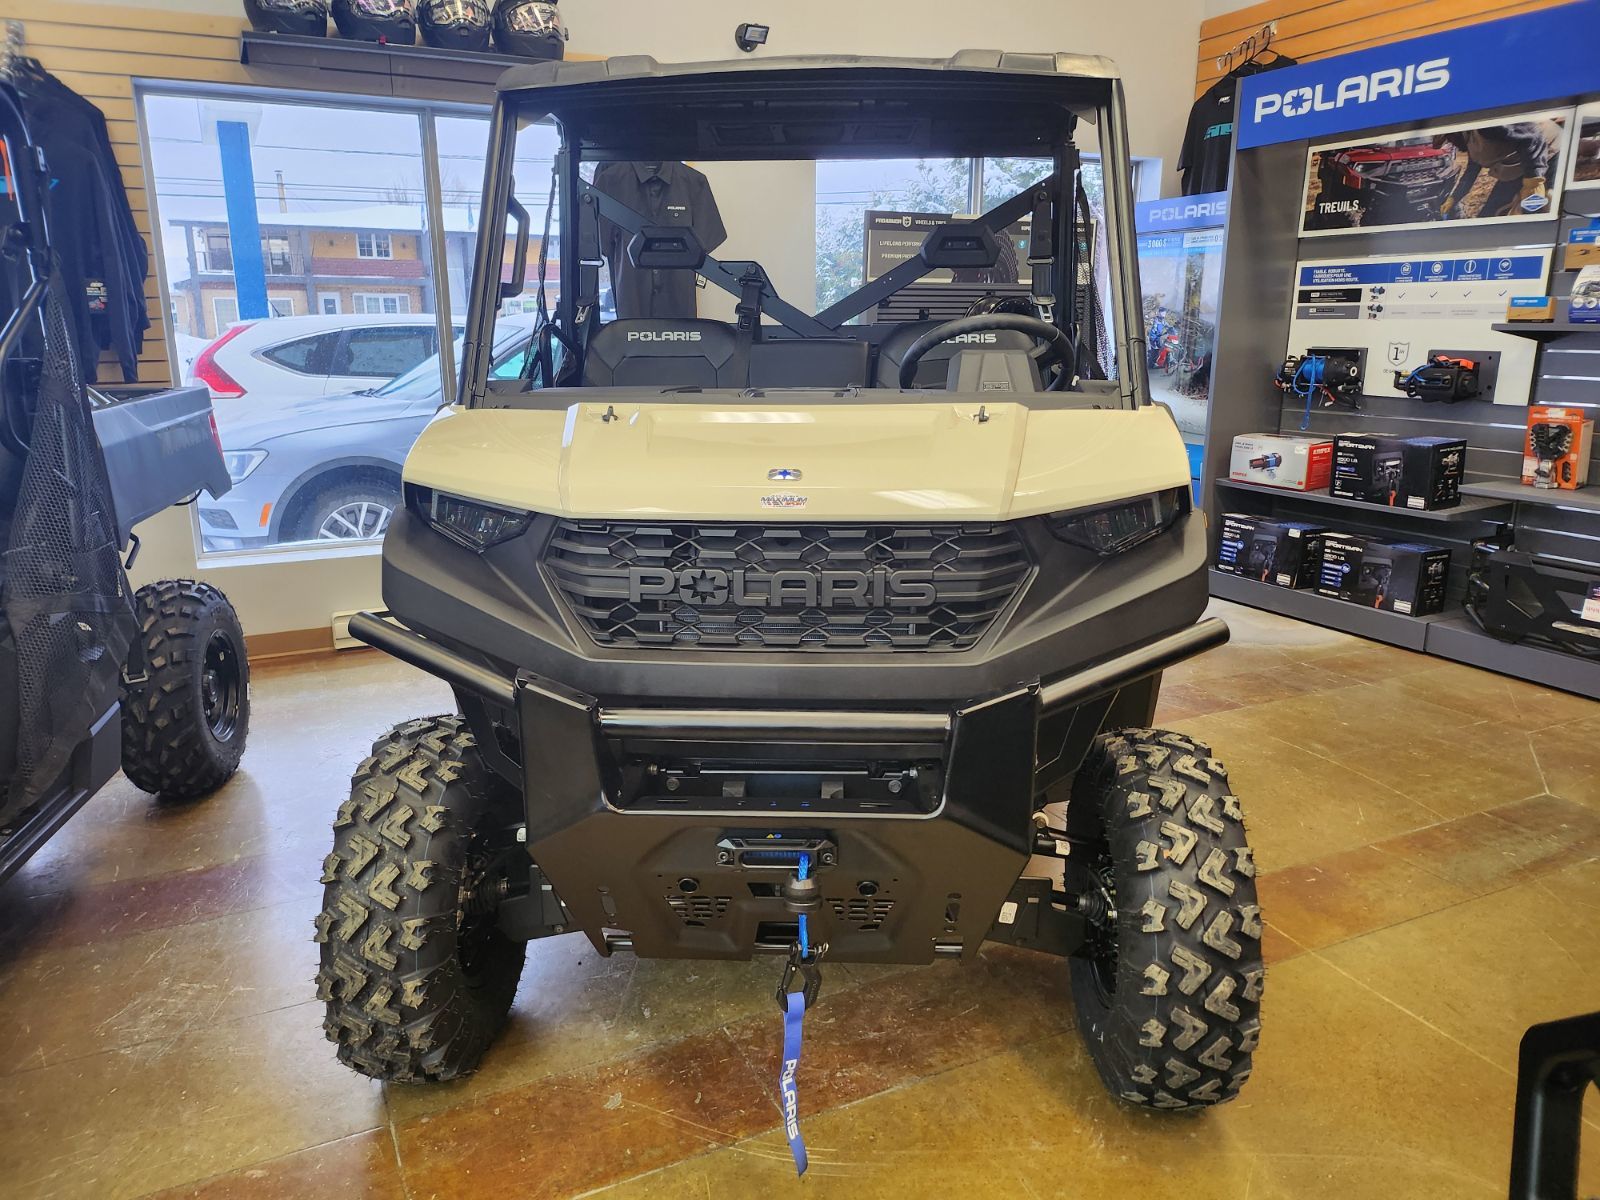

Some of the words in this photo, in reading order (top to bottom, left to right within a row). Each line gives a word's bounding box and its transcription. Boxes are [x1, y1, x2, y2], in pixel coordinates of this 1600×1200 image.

[1254, 57, 1450, 123] POLARIS
[1149, 201, 1226, 223] POLARIS
[1319, 200, 1359, 214] TREUILS
[627, 331, 702, 342] POLARIS
[942, 333, 997, 344] LARIS
[629, 566, 937, 607] POLARIS
[782, 1059, 799, 1140] POLARIS
